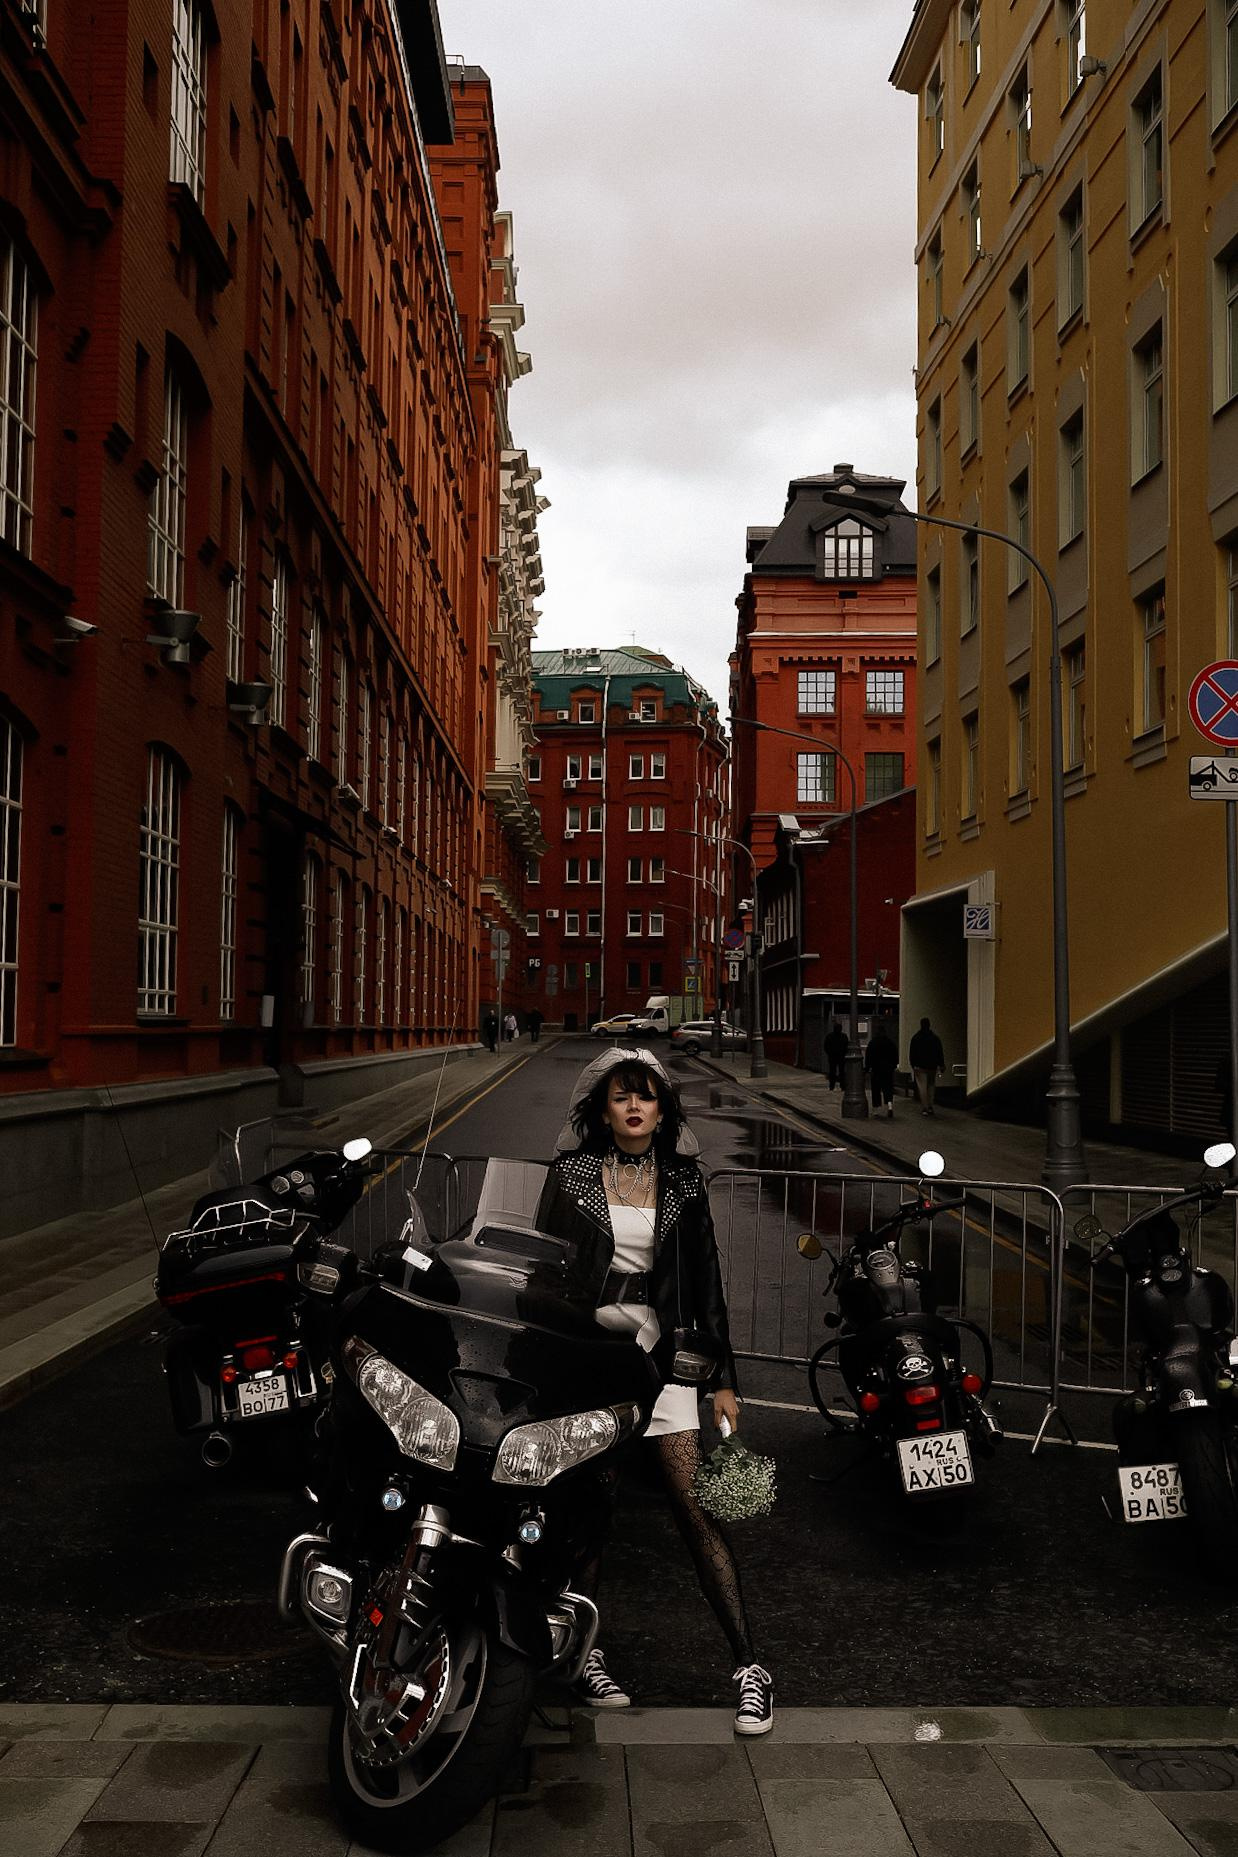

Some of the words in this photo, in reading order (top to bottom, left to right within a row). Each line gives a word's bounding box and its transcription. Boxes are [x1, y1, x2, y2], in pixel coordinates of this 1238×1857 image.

[245, 1379, 280, 1395] 4358
[267, 1395, 284, 1410] 77
[910, 1438, 958, 1461] 1424
[936, 1457, 954, 1466] RUS
[943, 1464, 967, 1484] 50
[1130, 1468, 1179, 1490] 8487
[1160, 1488, 1179, 1496] RUS
